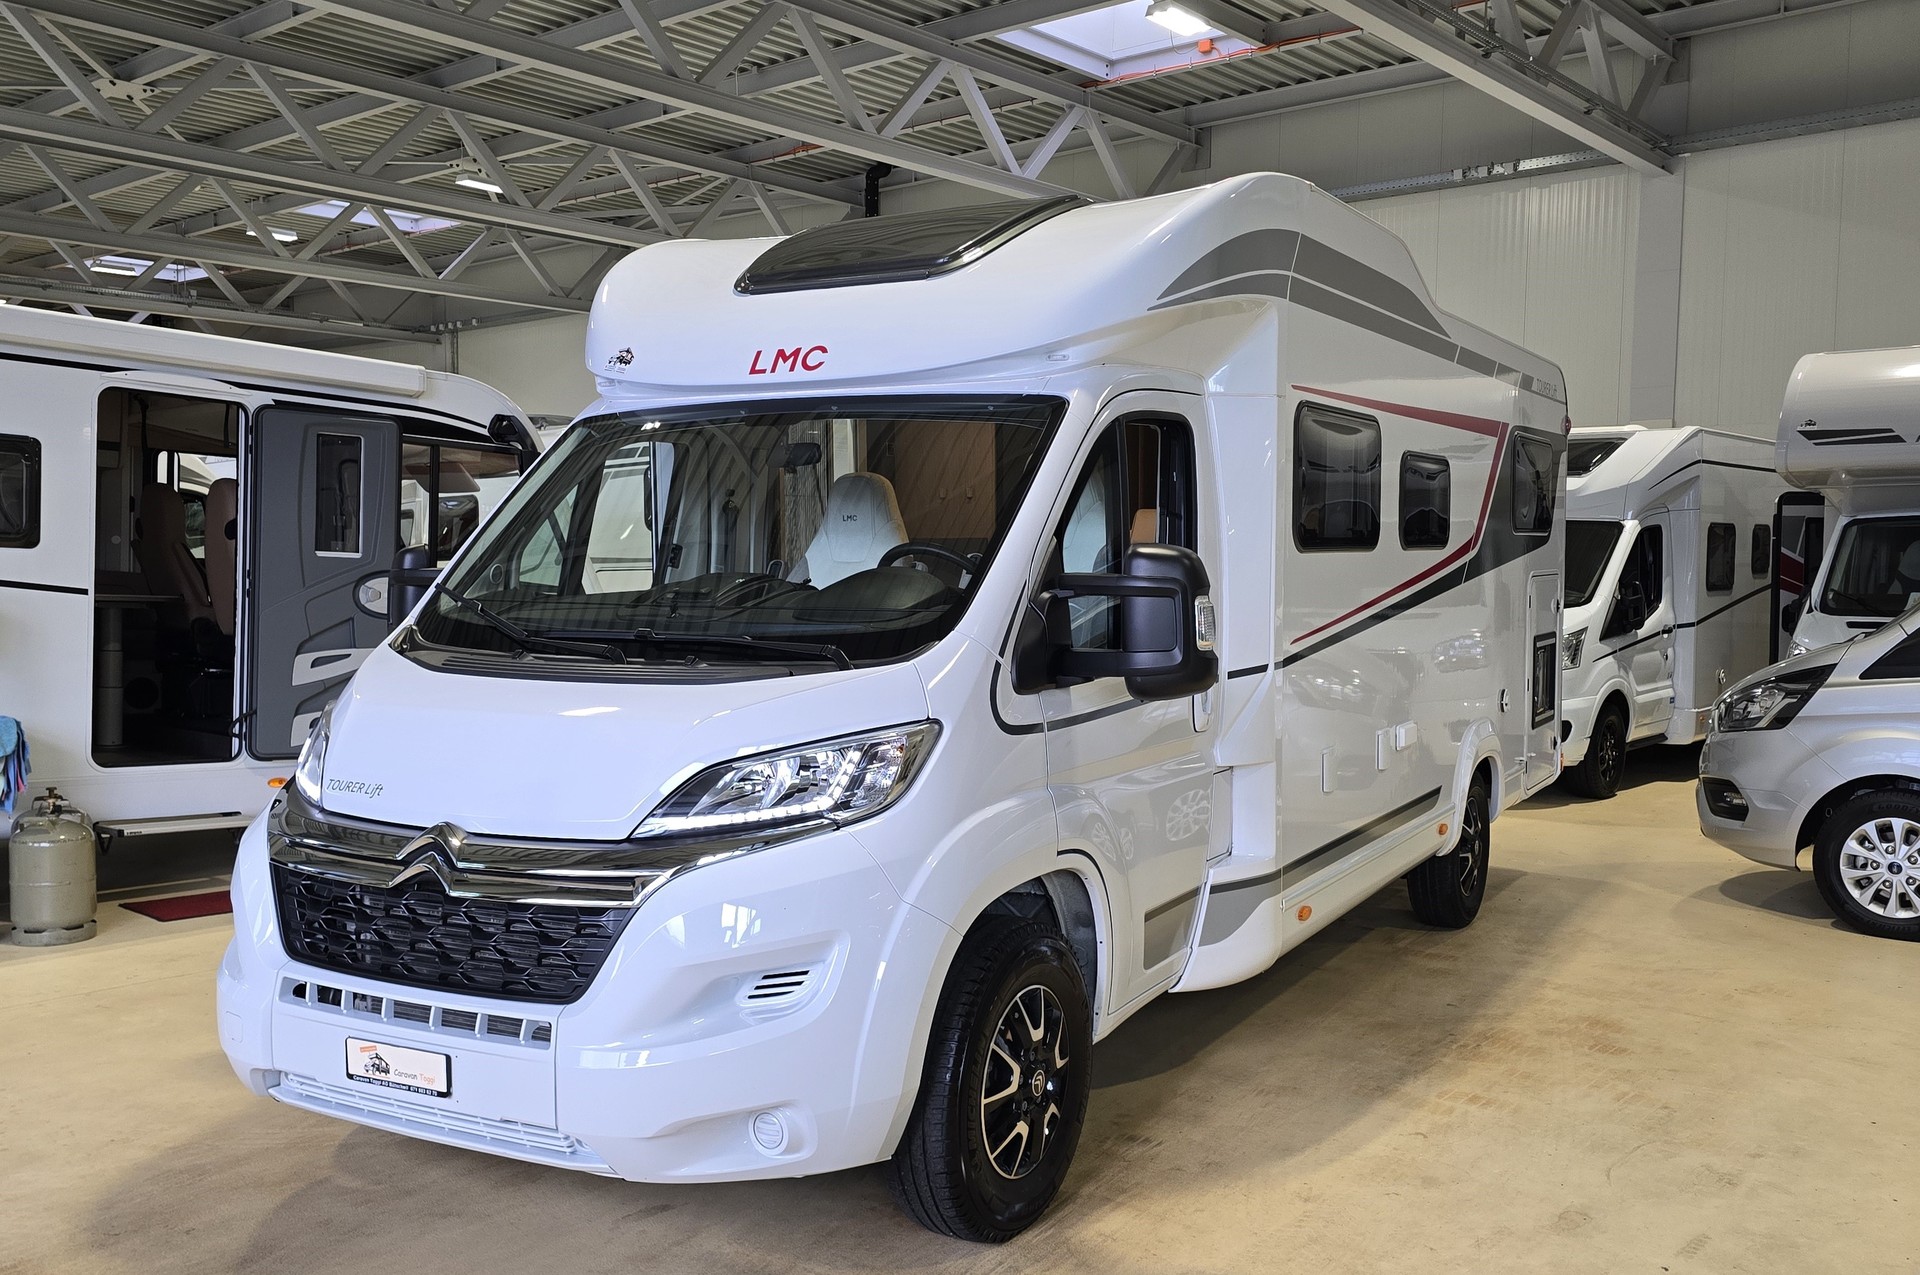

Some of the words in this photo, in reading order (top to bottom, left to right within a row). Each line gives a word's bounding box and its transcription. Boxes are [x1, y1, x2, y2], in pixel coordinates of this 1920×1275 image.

[749, 345, 828, 375] LMC
[842, 514, 858, 522] LMC
[326, 779, 366, 794] TOURER
[364, 784, 384, 799] Lift
[394, 1068, 418, 1081] Caravan
[419, 1073, 436, 1086] Toggi
